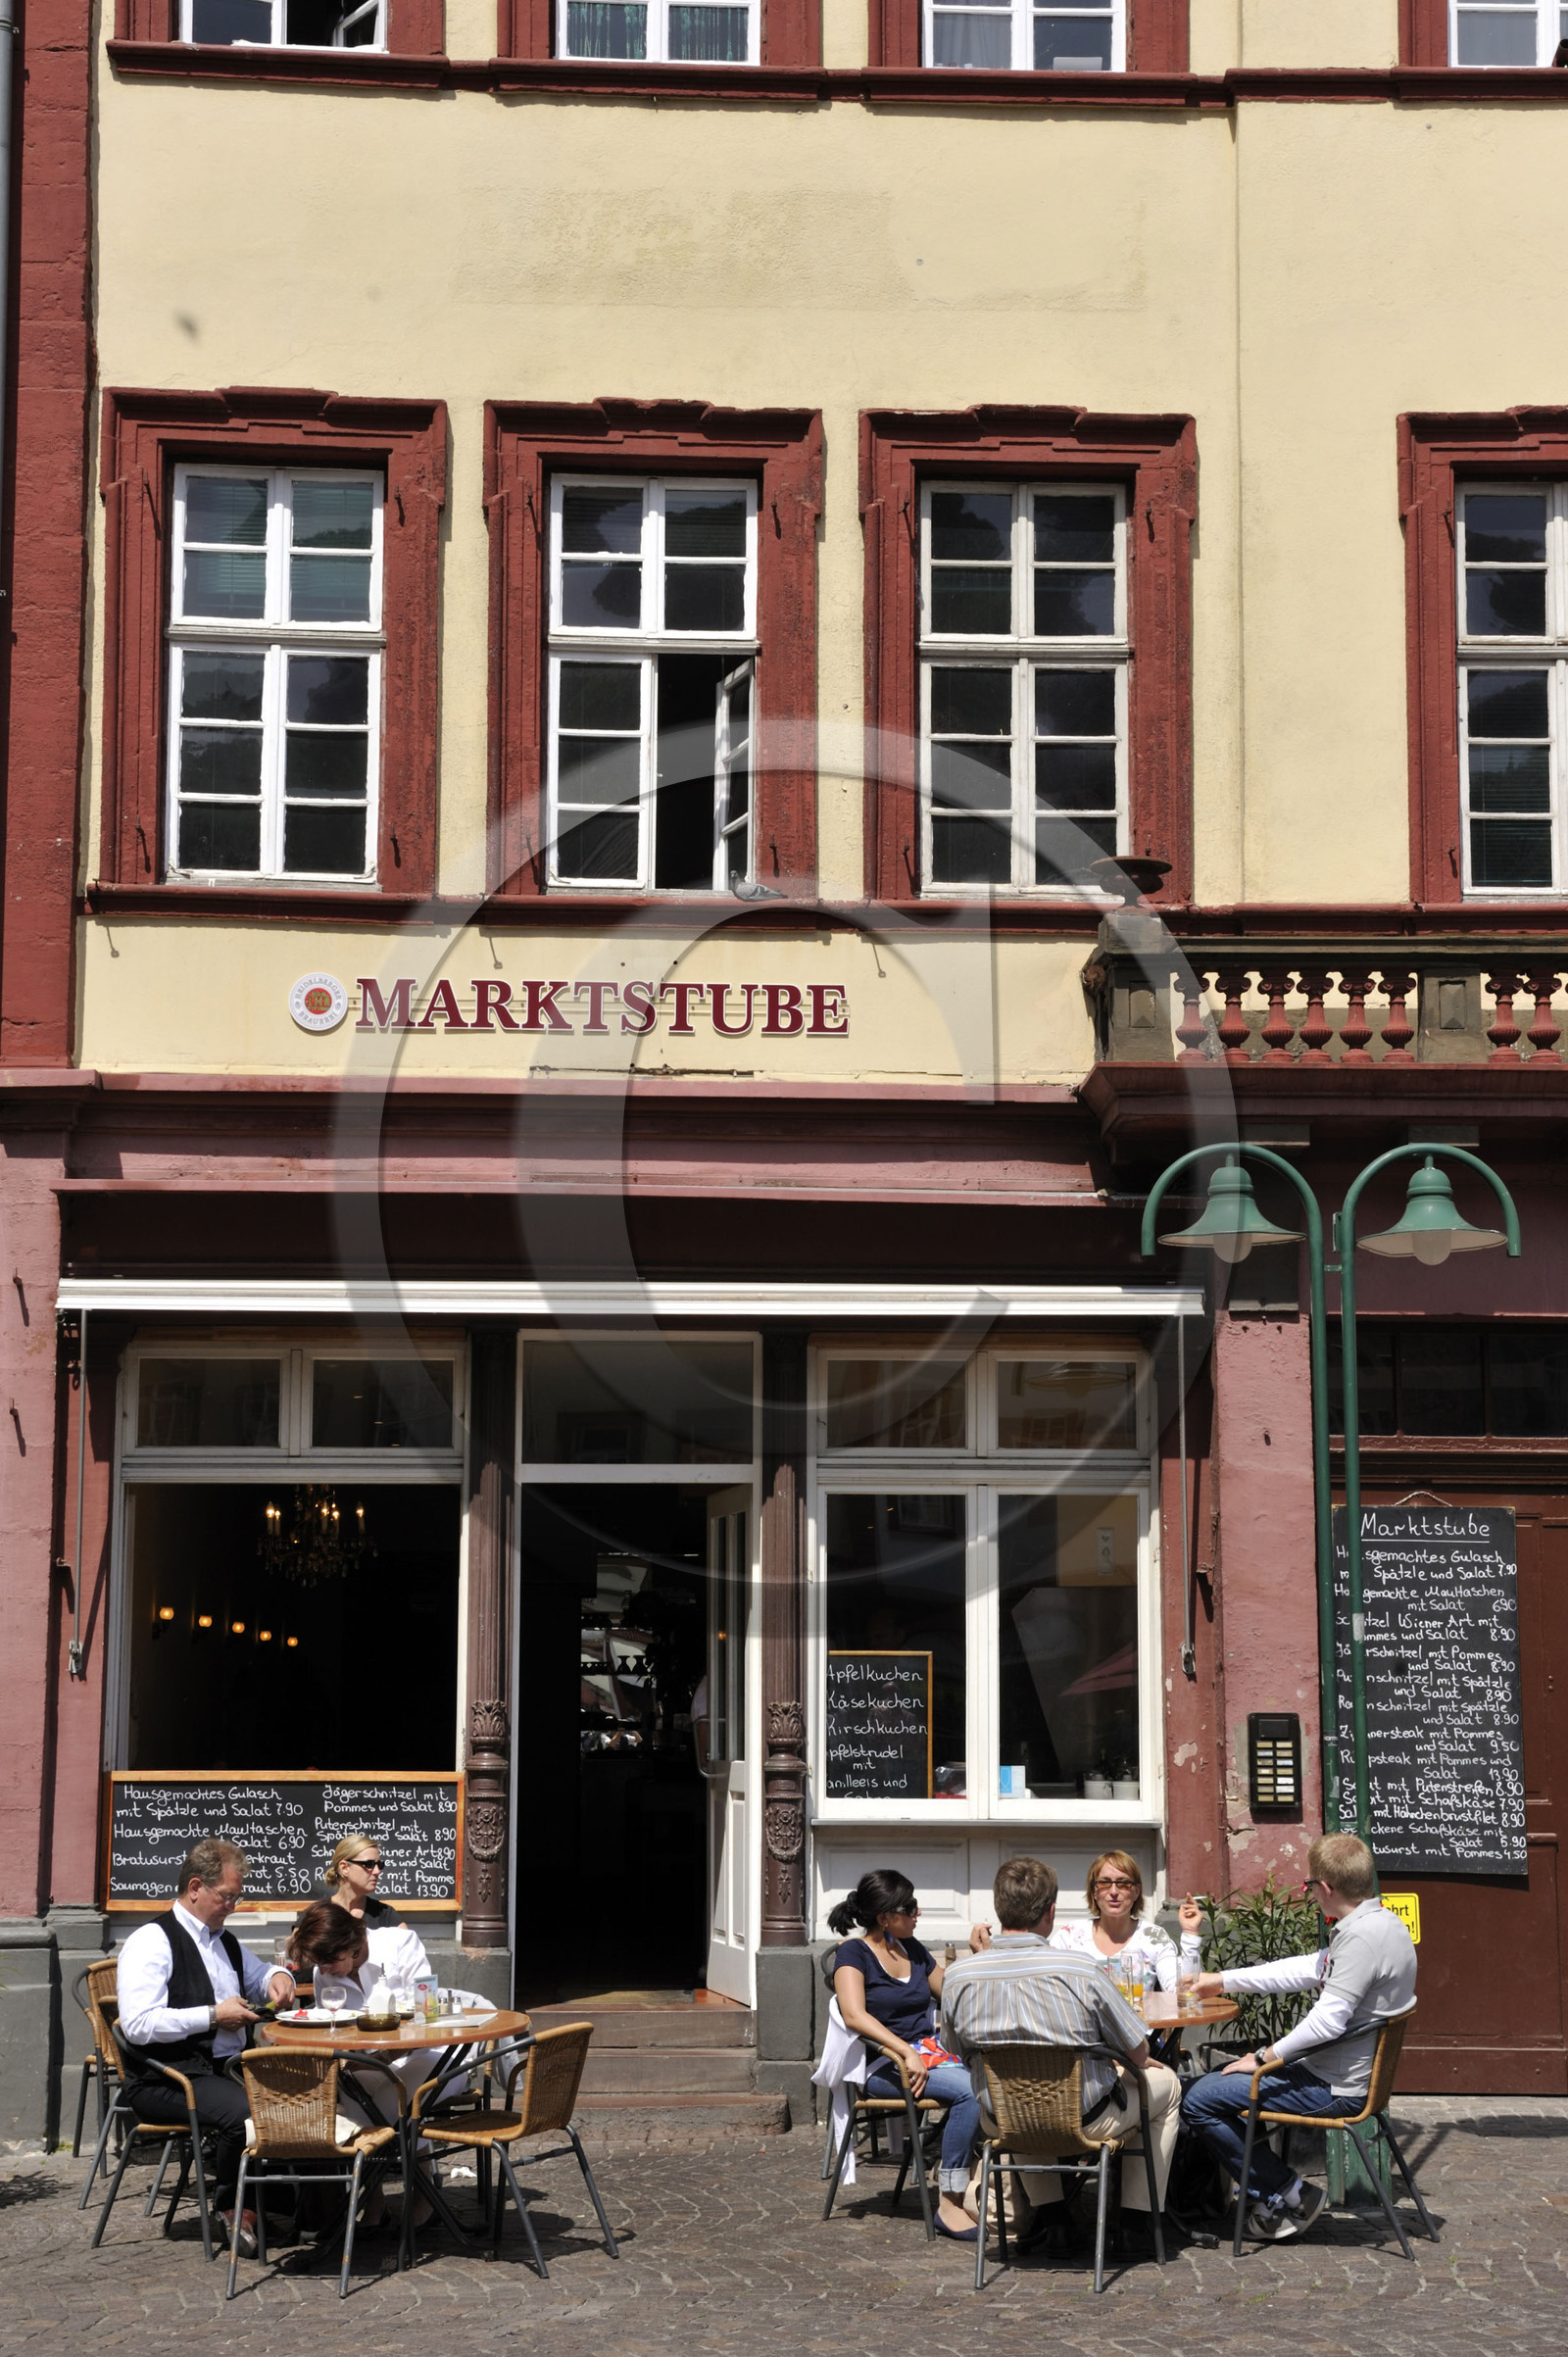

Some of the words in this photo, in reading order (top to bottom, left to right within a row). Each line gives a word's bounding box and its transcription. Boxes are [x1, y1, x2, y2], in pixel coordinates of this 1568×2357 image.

[356, 978, 850, 1035] MARKTSTUBE
[1361, 1512, 1490, 1537] Marktstube
[1451, 1550, 1505, 1564] Gulasch
[1431, 1567, 1453, 1579] und
[1459, 1565, 1495, 1580] Salat
[1425, 1586, 1504, 1597] Maultaschen
[1408, 1598, 1428, 1611] mit
[1430, 1600, 1465, 1611] Salat
[1398, 1613, 1443, 1629] Wiener
[1447, 1613, 1475, 1627] Art
[1478, 1615, 1502, 1628] mit
[1364, 1631, 1397, 1641] ommes
[1401, 1630, 1423, 1640] und
[1426, 1629, 1469, 1641] Salat
[1491, 1629, 1515, 1641] 8.90
[1429, 1646, 1449, 1660] mit
[1451, 1645, 1502, 1662] Pommes
[1408, 1660, 1429, 1670] und
[1435, 1659, 1477, 1672] Salat
[1492, 1661, 1515, 1672] 8.90
[1438, 1674, 1460, 1687] mit
[1395, 1685, 1416, 1698] und
[1422, 1685, 1462, 1699] Salat
[1486, 1690, 1511, 1702] 8.90
[1439, 1700, 1458, 1712] mit
[1463, 1701, 1507, 1715] Spätzle
[1423, 1715, 1444, 1724] und
[1446, 1714, 1483, 1725] Salat
[1494, 1714, 1519, 1725] 8.90
[1430, 1729, 1451, 1739] mit
[1454, 1729, 1503, 1741] Pommes
[829, 1744, 904, 1761] pfelstrudel
[1416, 1741, 1436, 1750] und
[1440, 1741, 1476, 1751] Salat
[1491, 1741, 1519, 1753] 9.50
[853, 1757, 876, 1770] mit
[1417, 1753, 1440, 1765] mit
[1440, 1752, 1487, 1765] Pommes
[1491, 1754, 1512, 1765] und
[827, 1774, 878, 1789] anilleeis
[884, 1774, 907, 1788] und
[1423, 1767, 1461, 1779] Salat
[1489, 1769, 1518, 1781] 13.90
[124, 1784, 225, 1806] Hausgemachtes
[228, 1787, 282, 1799] Gulasch
[322, 1784, 416, 1803] Jägerschnitzel
[423, 1788, 449, 1801] mit
[1388, 1778, 1410, 1791] mit
[1416, 1778, 1494, 1797] Putenstreifen
[1495, 1782, 1524, 1796] 8.90
[324, 1800, 375, 1812] Pommes
[379, 1801, 398, 1811] und
[401, 1801, 435, 1812] Salat
[1390, 1792, 1415, 1804] mit
[1419, 1792, 1495, 1809] Schafskäse
[1499, 1798, 1524, 1811] 7.90
[117, 1802, 142, 1817] mit
[204, 1803, 226, 1816] und
[231, 1803, 271, 1816] Salat
[276, 1802, 303, 1816] 7.90
[1374, 1805, 1393, 1818] mit
[1501, 1813, 1525, 1827] 8.90
[316, 1817, 395, 1832] Putenschnitzel
[401, 1820, 421, 1833] mit
[1408, 1823, 1481, 1839] Schafskäse
[1484, 1829, 1506, 1839] mit
[114, 1824, 210, 1844] Hausgemachte
[215, 1823, 308, 1837] Maultaschen
[395, 1830, 428, 1841] Salat
[435, 1828, 456, 1841] 8.90
[231, 1836, 271, 1848] Salat
[278, 1836, 305, 1849] 6.90
[1449, 1838, 1483, 1847] Salat
[1500, 1836, 1526, 1848] 5.90
[416, 1844, 439, 1857] Art
[1426, 1844, 1450, 1855] mit
[1456, 1848, 1502, 1858] Pommes
[1503, 1850, 1527, 1859] 4.50
[420, 1858, 450, 1870] Salat
[275, 1867, 309, 1879] 5.50
[387, 1870, 411, 1881] mit
[416, 1871, 455, 1884] Pommes
[110, 1877, 172, 1897] Saumagen
[277, 1879, 312, 1894] 6.90
[374, 1882, 411, 1894] Salat
[416, 1885, 448, 1897] 13.90
